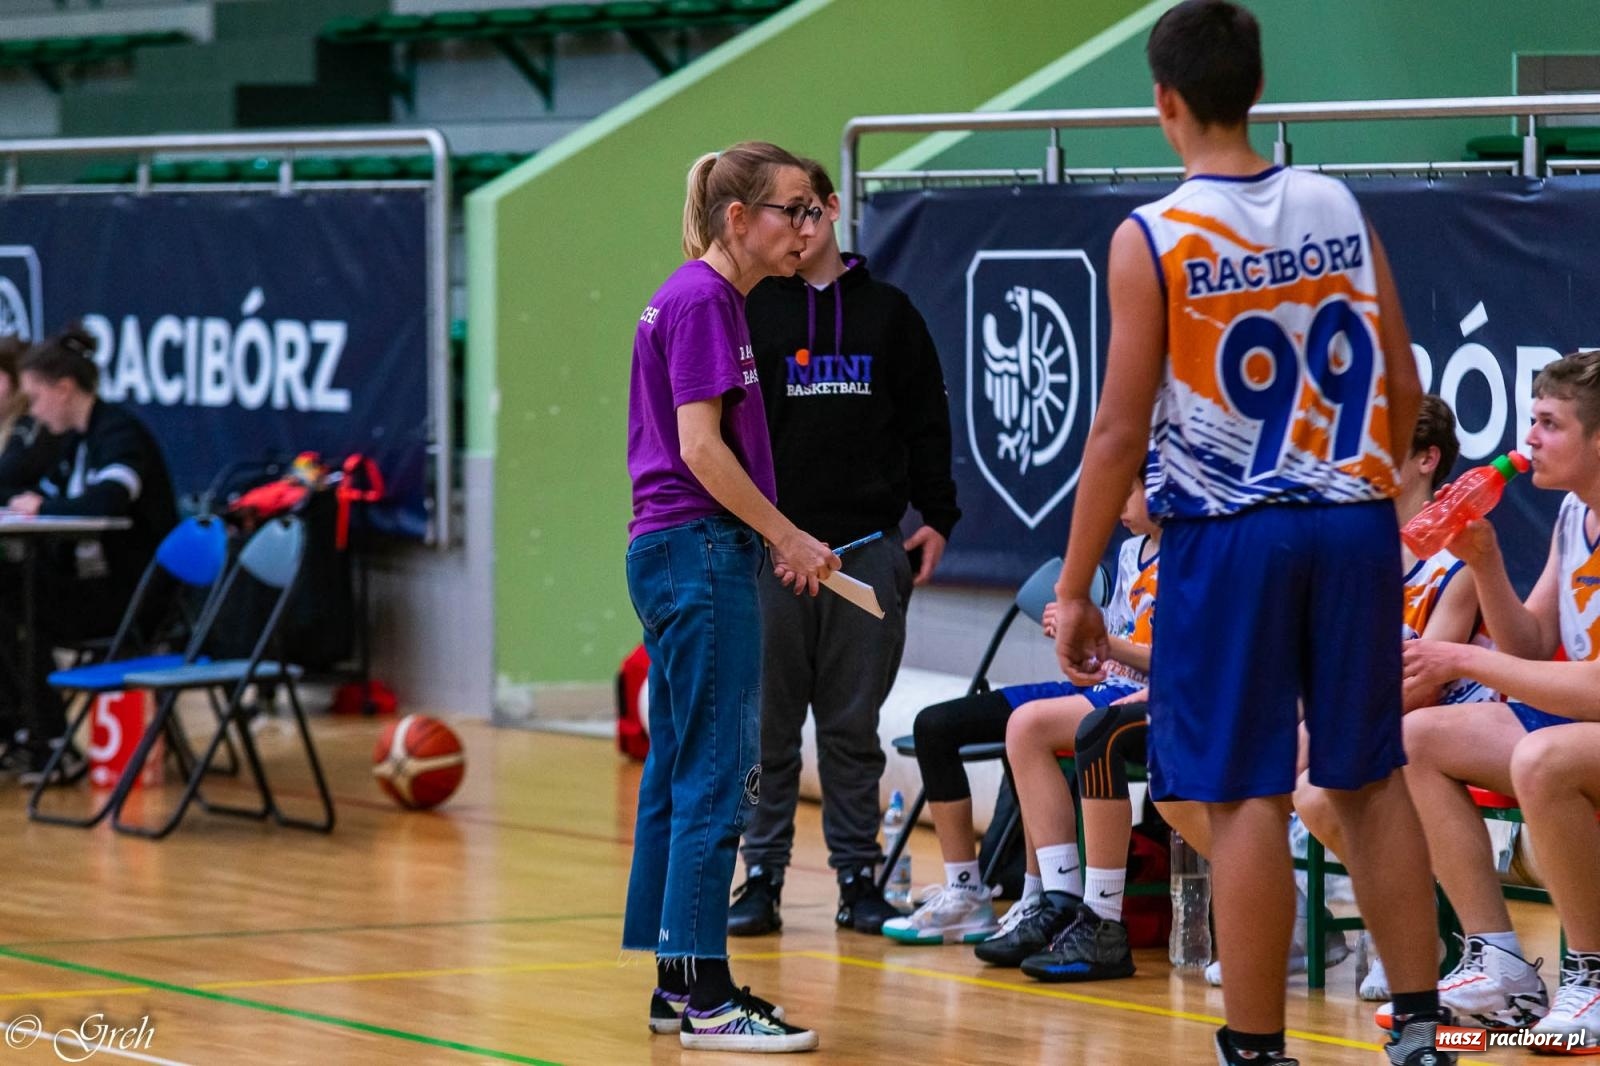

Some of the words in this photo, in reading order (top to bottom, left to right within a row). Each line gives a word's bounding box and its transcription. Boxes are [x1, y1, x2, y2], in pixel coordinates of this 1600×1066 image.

[1186, 234, 1363, 295] RACIBÓRZ
[84, 286, 351, 412] RACIBÓRZ
[785, 355, 872, 384] MINI
[786, 382, 872, 396] BASKETBALL
[1218, 297, 1376, 482] 99
[88, 691, 125, 762] 5
